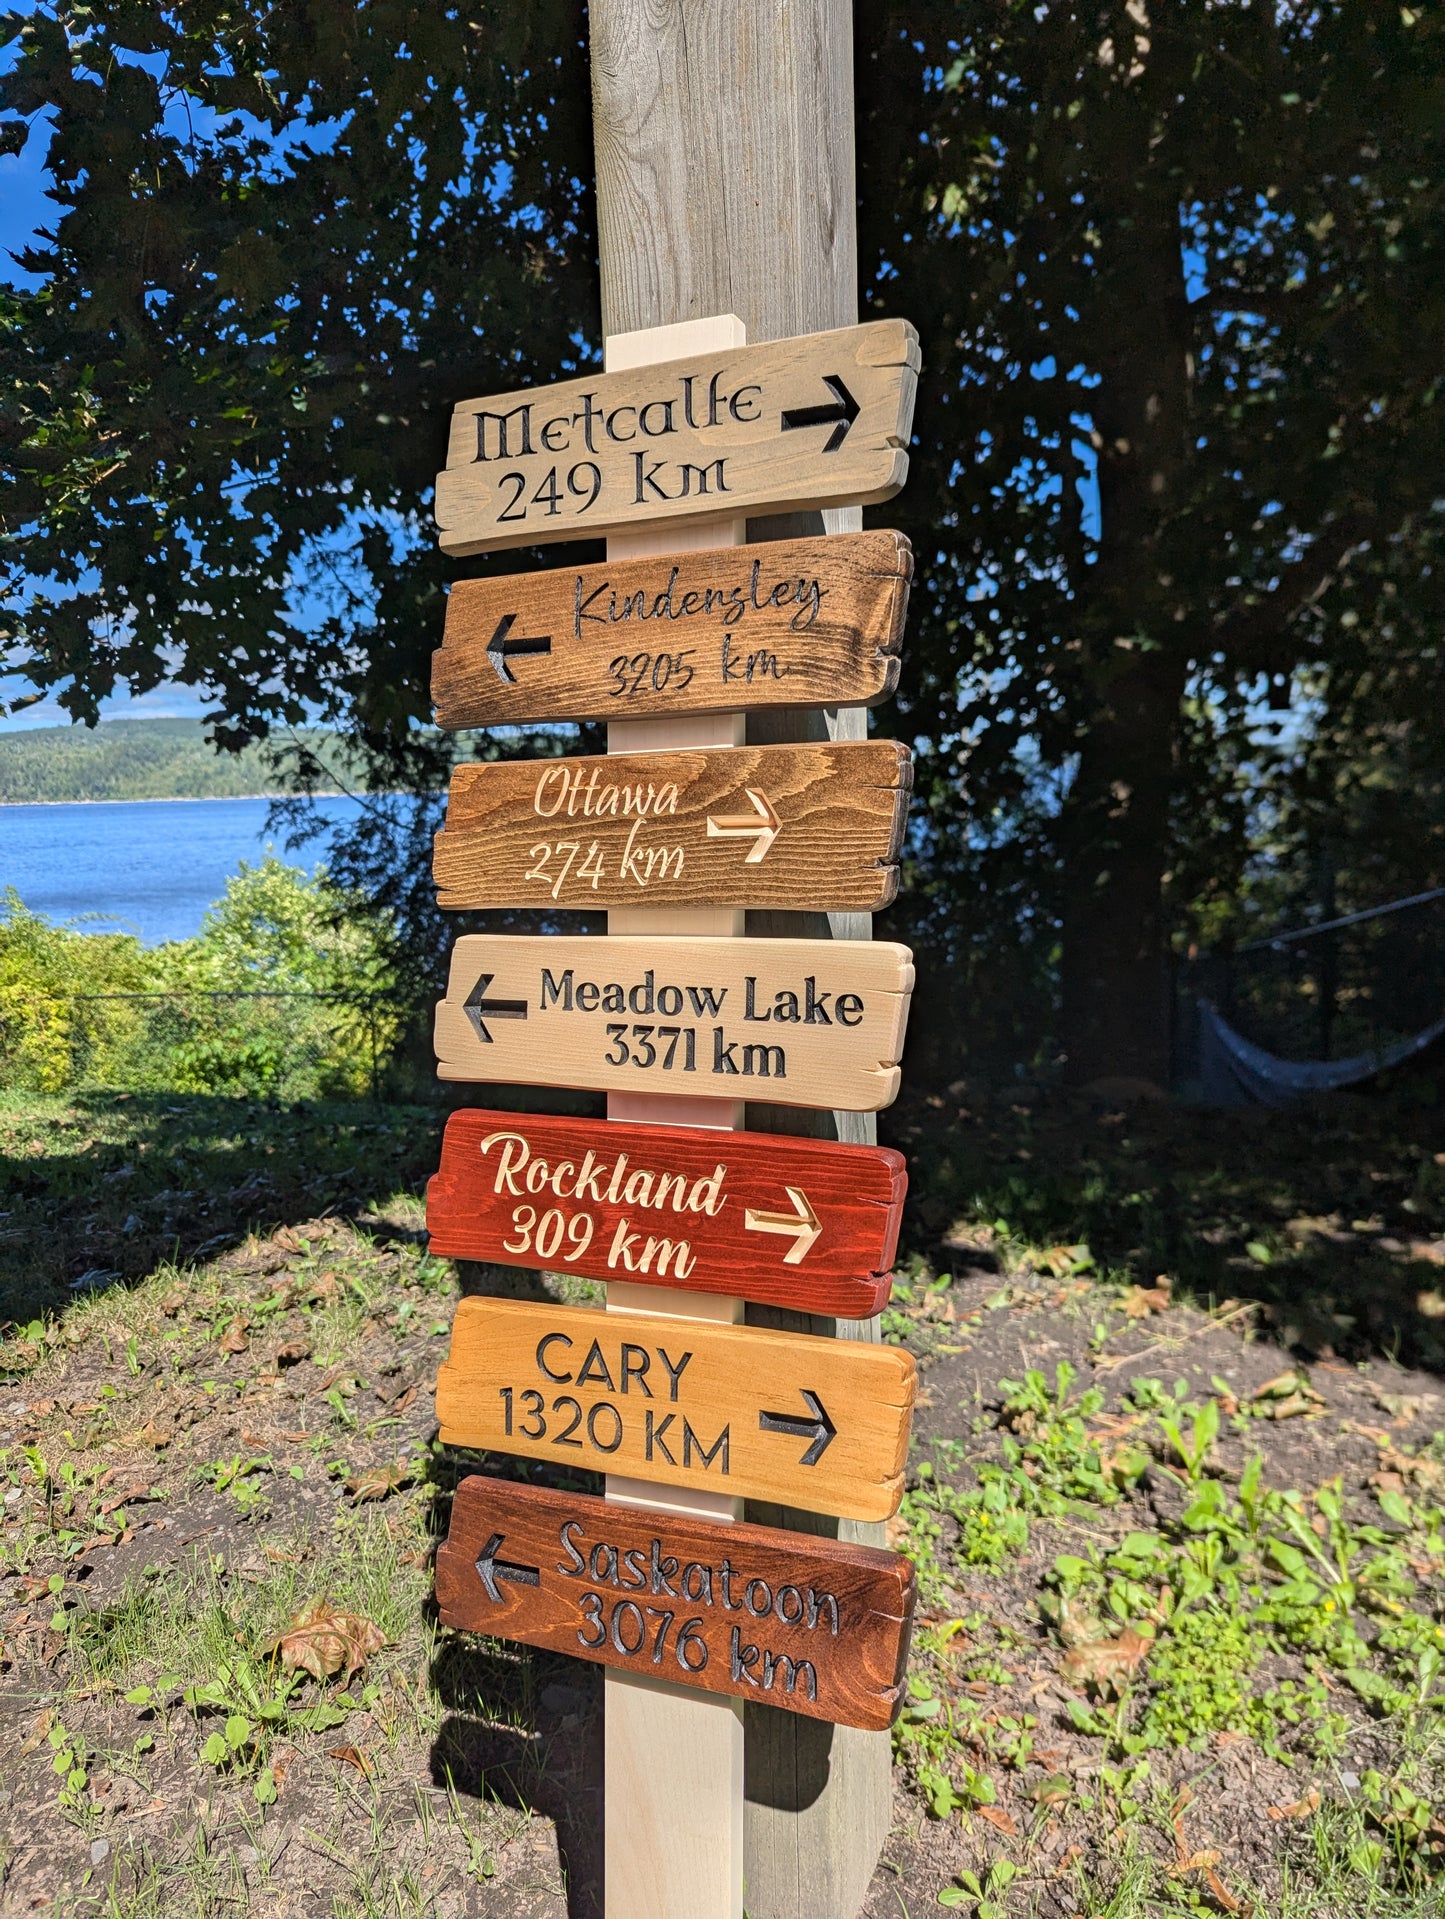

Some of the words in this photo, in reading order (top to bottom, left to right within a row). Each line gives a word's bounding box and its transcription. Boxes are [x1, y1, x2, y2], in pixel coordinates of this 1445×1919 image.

[471, 370, 762, 465] Metcalfe
[496, 461, 601, 523] 249
[574, 559, 829, 640] Kindersley
[609, 649, 697, 697] 3205
[722, 633, 789, 684] km
[534, 766, 679, 817] Ottawa
[524, 839, 605, 899] 274
[620, 818, 685, 887] km
[539, 969, 728, 1019] Meadow
[744, 976, 864, 1027] Lake
[605, 1024, 696, 1072] 3371
[712, 1027, 787, 1078] km
[481, 1131, 727, 1217] Rockland
[503, 1204, 594, 1262] 309
[607, 1218, 697, 1280] km
[535, 1332, 693, 1402] CARY
[499, 1387, 623, 1454] 1320
[645, 1409, 730, 1476] KM
[557, 1521, 839, 1636] Saskatoon
[577, 1592, 708, 1673] 3076
[731, 1626, 817, 1701] km
